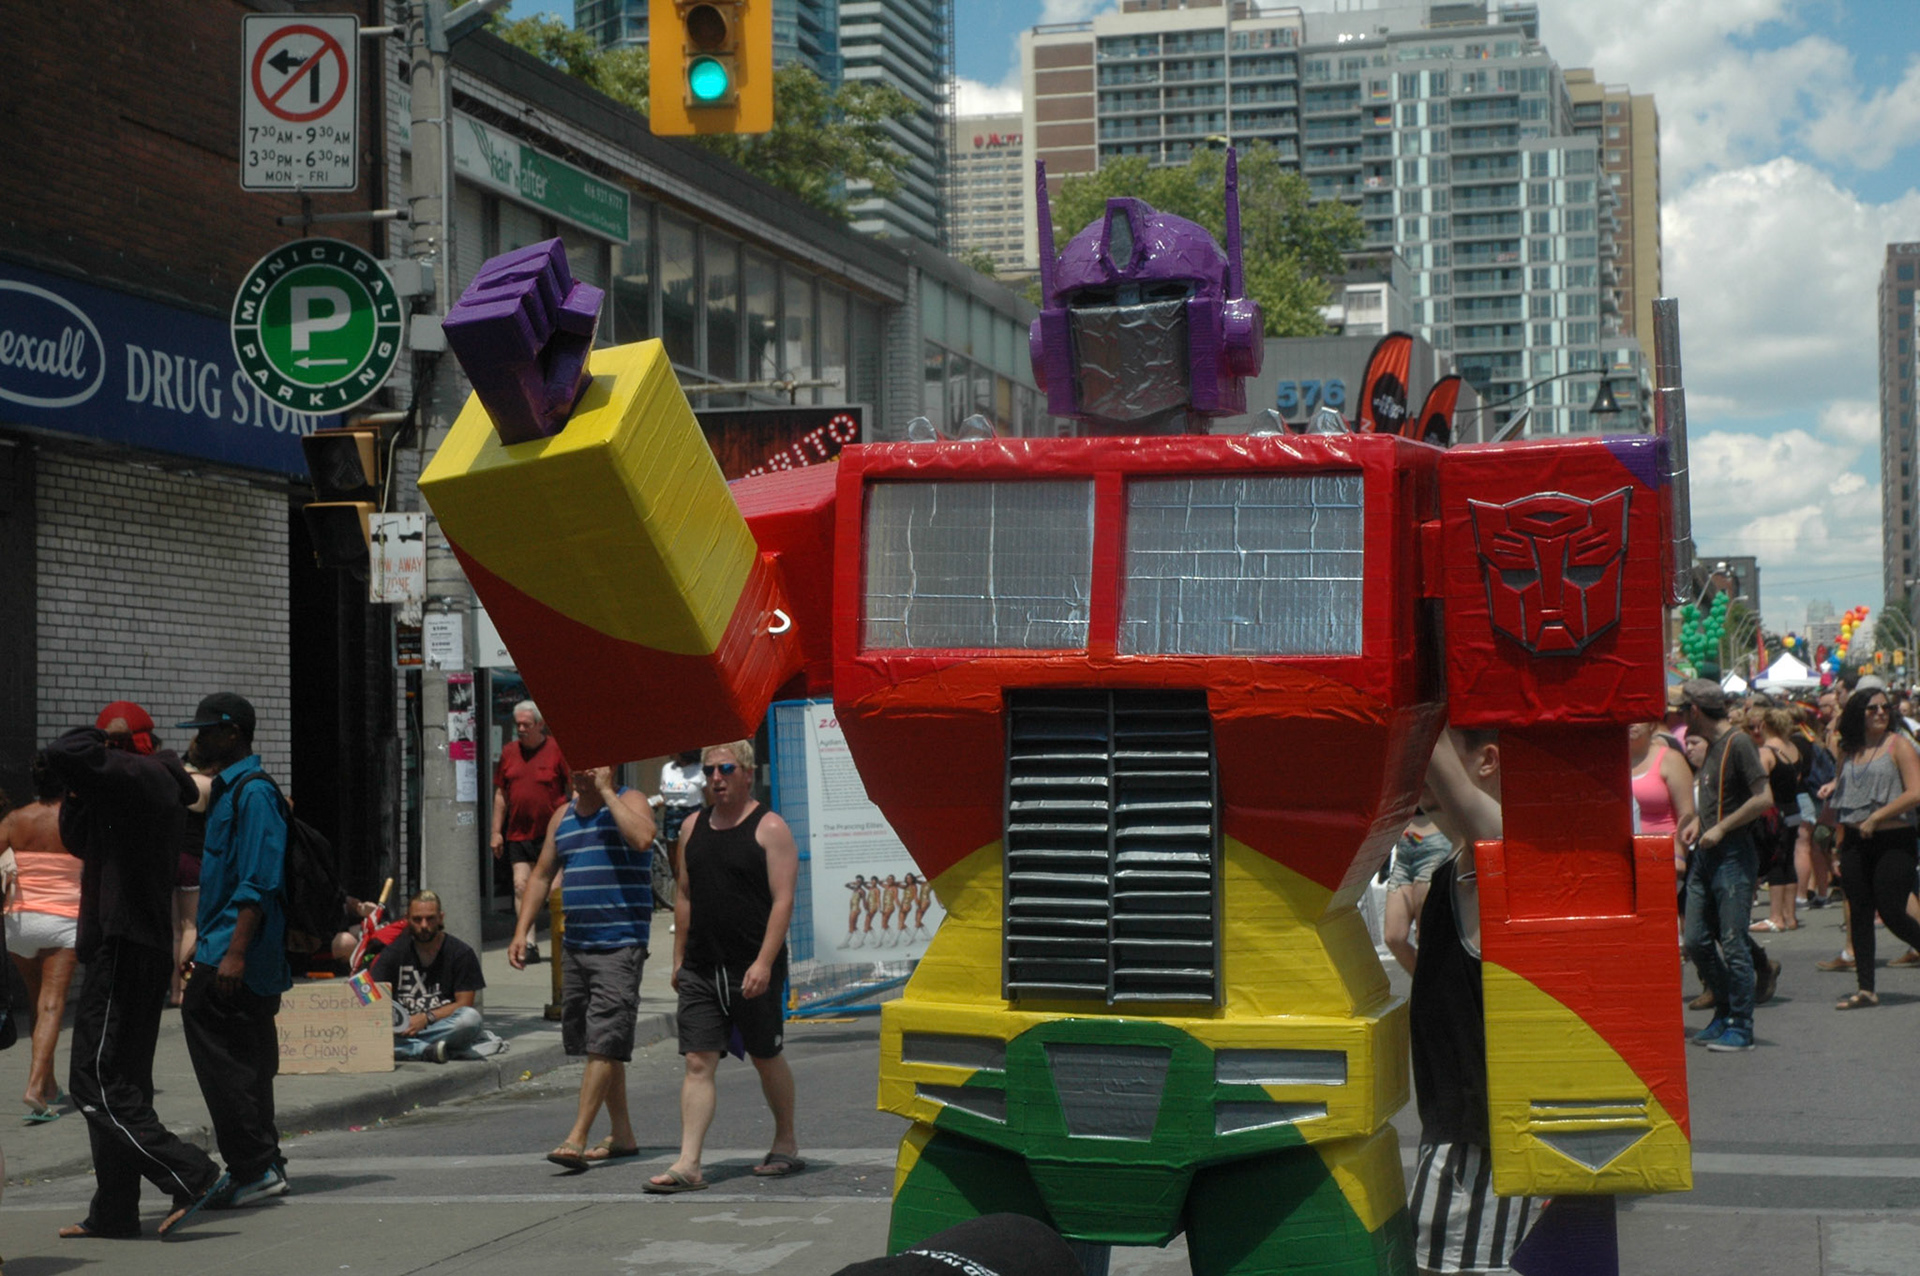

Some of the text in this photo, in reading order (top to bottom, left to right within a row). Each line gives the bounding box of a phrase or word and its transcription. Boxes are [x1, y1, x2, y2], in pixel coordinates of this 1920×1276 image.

[265, 171, 292, 181] MON
[309, 171, 328, 181] FRI
[522, 157, 550, 200] after
[241, 247, 393, 321] MUNICIPAL
[290, 285, 353, 352] P
[125, 343, 222, 420] DRUG
[242, 341, 393, 407] PARKING
[1277, 378, 1346, 408] 576
[398, 556, 423, 573] AWAY
[819, 717, 841, 729] 20
